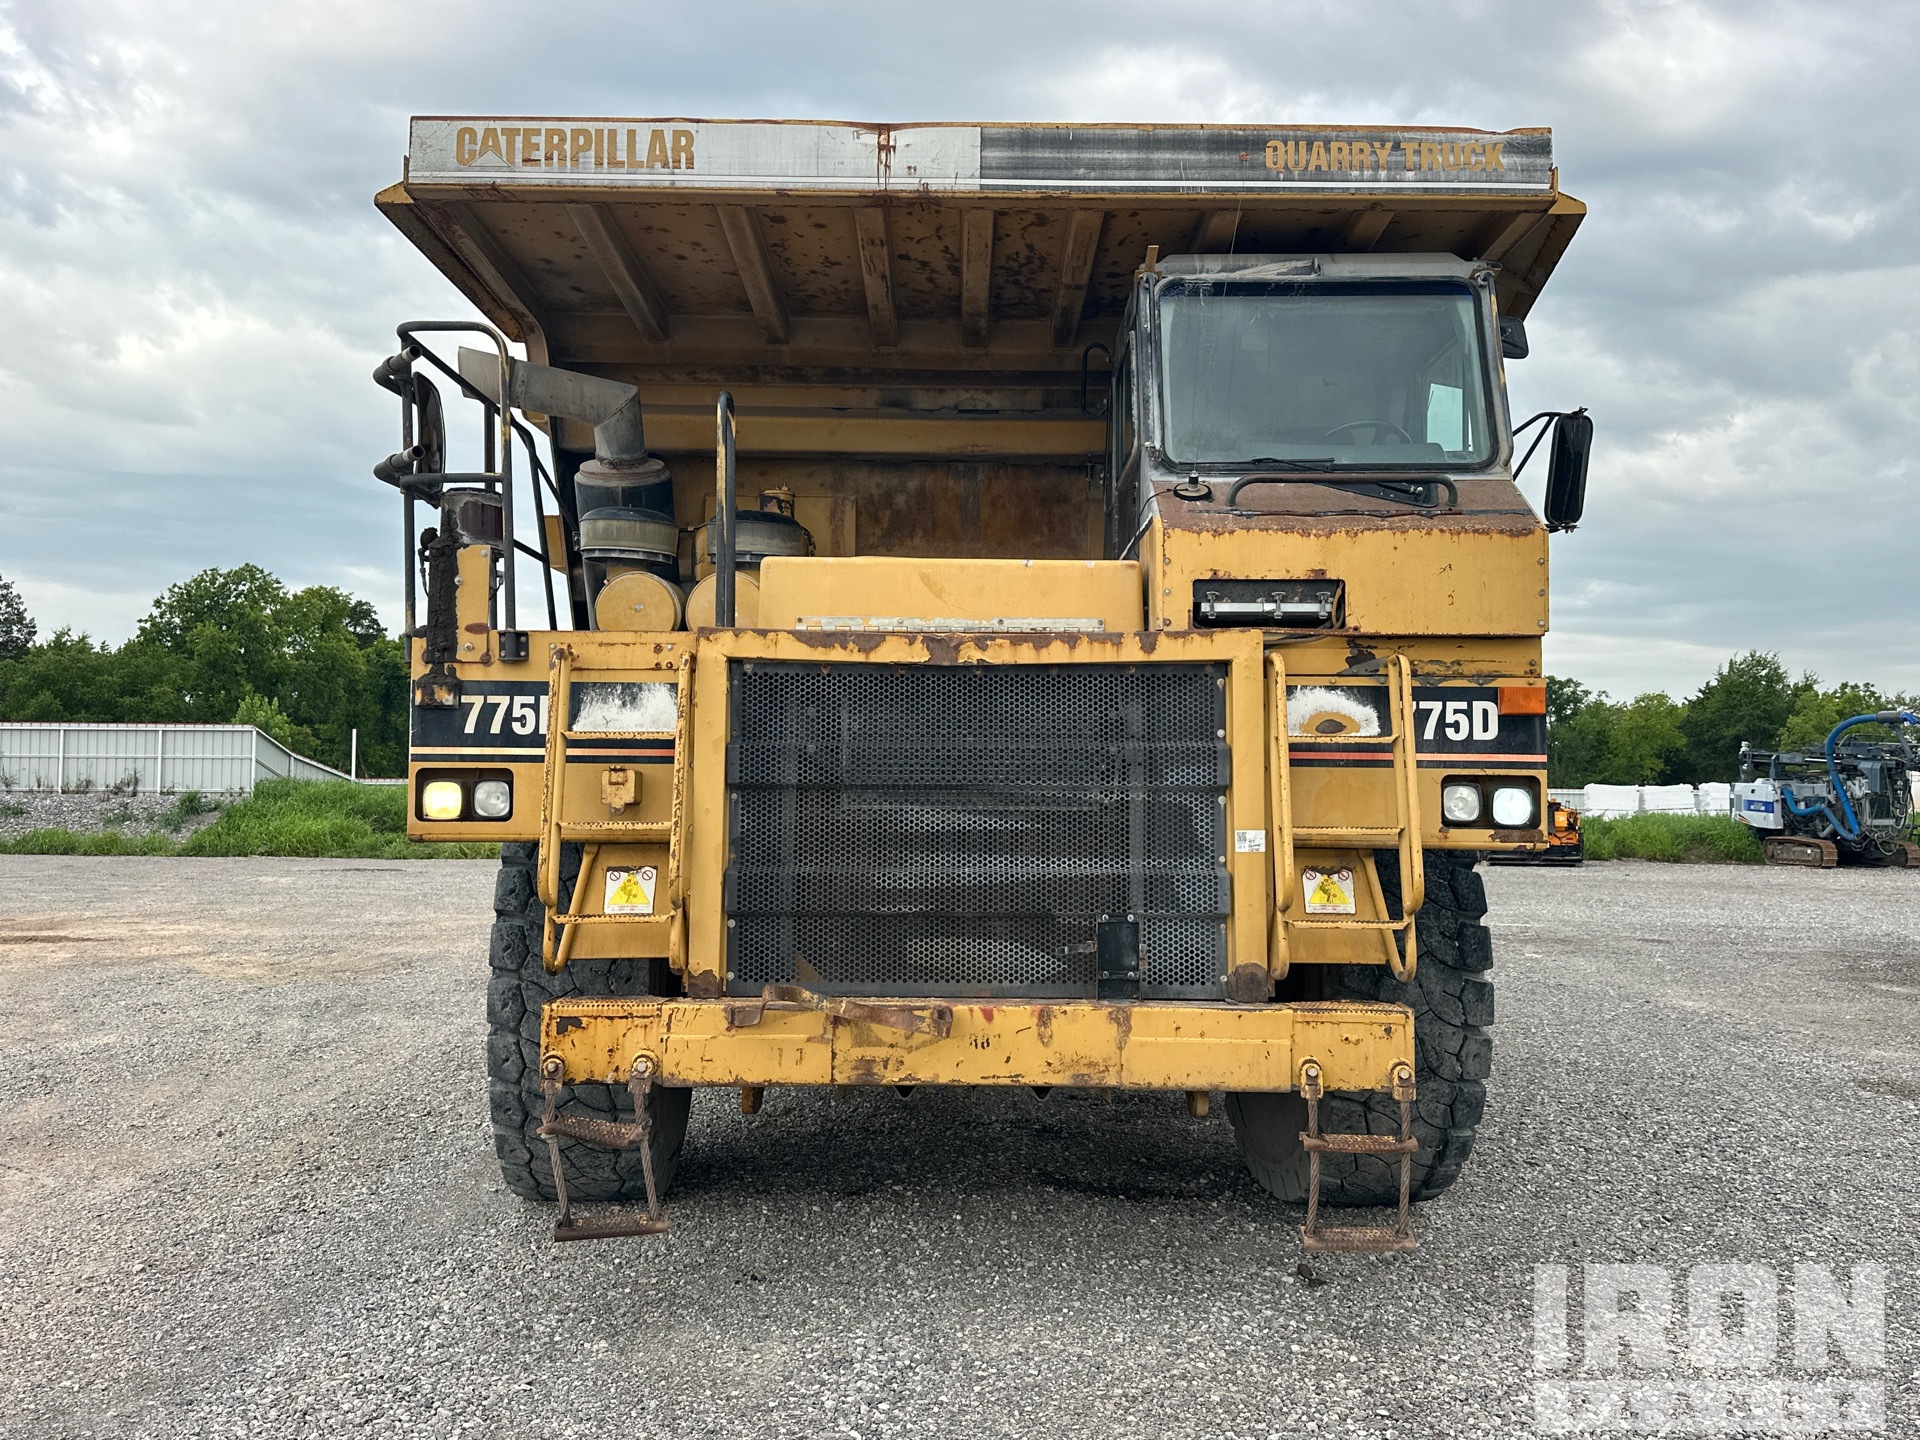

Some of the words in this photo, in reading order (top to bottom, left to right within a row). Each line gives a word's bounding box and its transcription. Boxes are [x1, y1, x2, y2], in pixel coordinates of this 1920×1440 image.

[456, 127, 695, 169] CATERPILLAR
[1265, 140, 1394, 172] QUARRY
[1400, 140, 1505, 172] TRUCK
[1400, 701, 1499, 740] 75D
